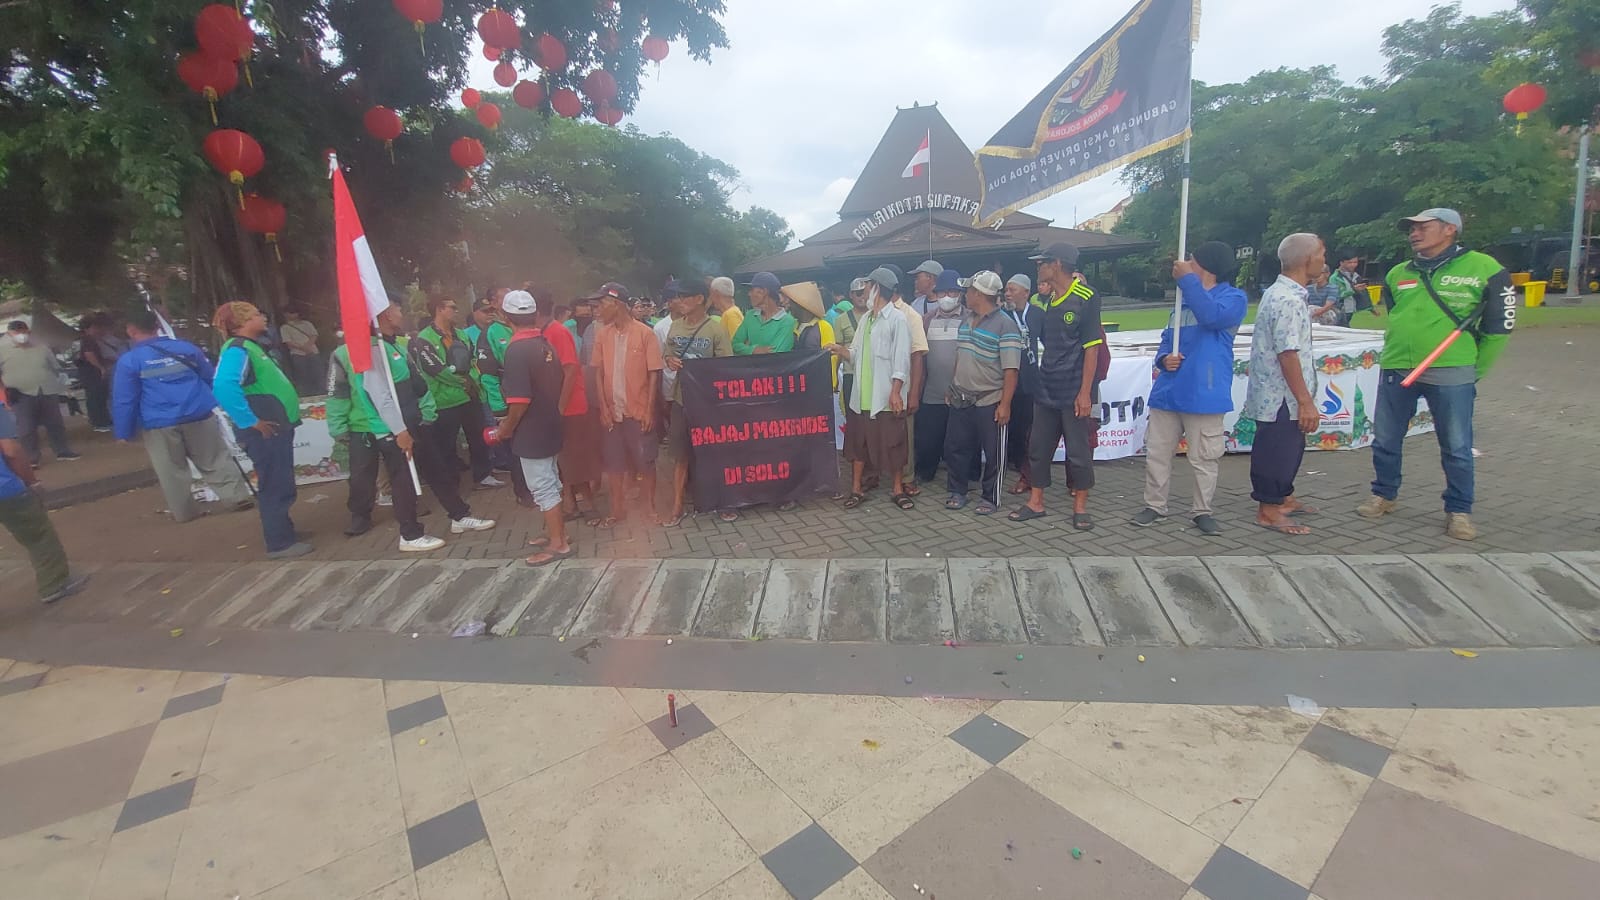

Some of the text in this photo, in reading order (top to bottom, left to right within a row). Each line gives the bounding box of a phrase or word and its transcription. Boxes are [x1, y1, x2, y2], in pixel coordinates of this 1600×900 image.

[690, 422, 750, 446] BAJAJ
[1110, 429, 1135, 438] RODA
[724, 461, 790, 485] DI SOLO
